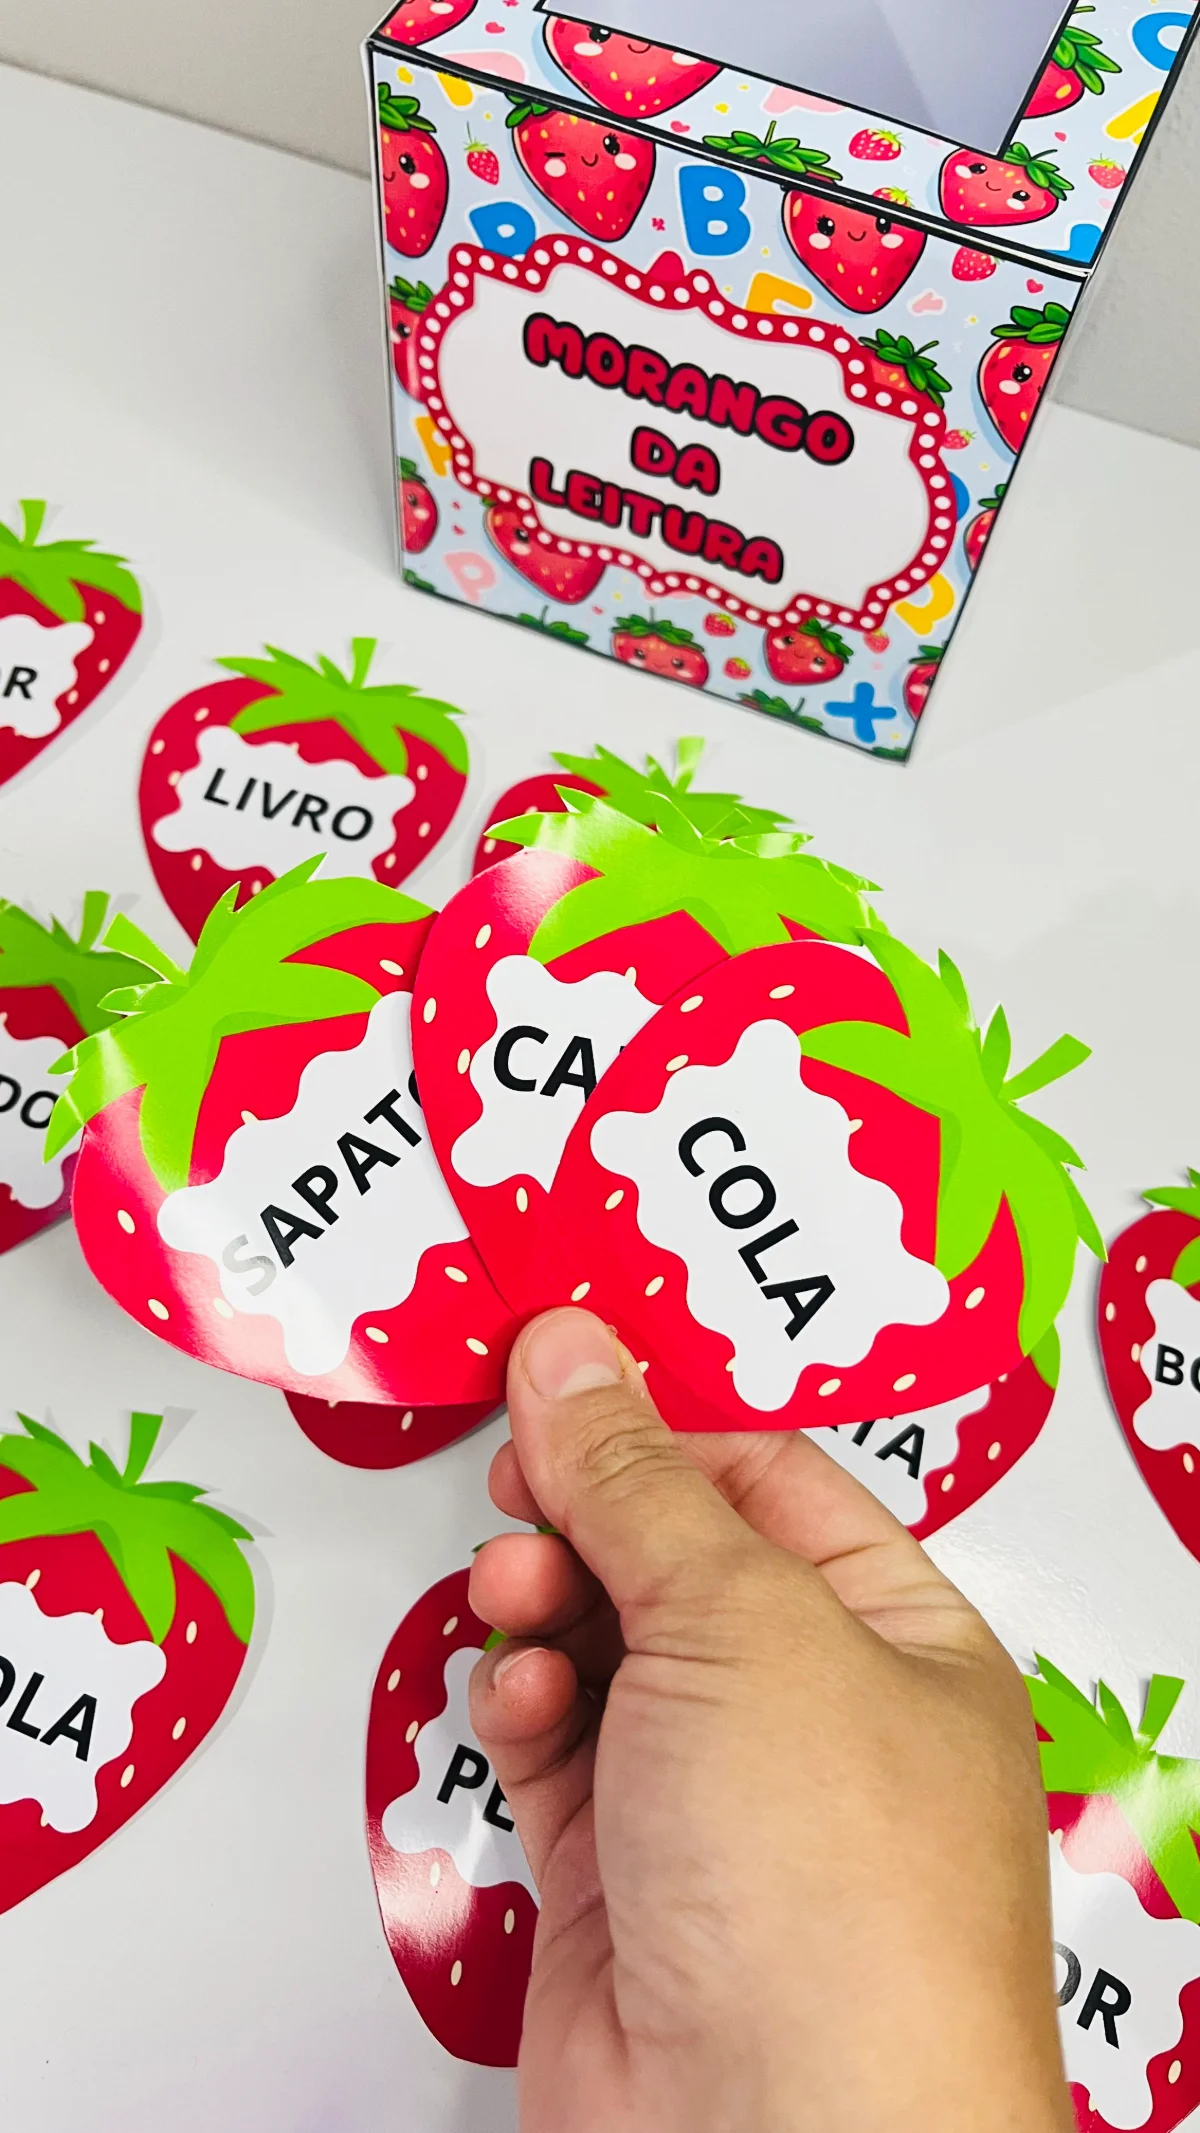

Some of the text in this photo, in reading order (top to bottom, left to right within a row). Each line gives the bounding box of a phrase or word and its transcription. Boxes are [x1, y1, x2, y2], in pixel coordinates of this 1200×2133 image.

[523, 312, 855, 465] MORANGO
[529, 456, 784, 584] LEITURA
[630, 426, 721, 495] DA
[203, 767, 374, 841] LIVRO
[493, 1025, 627, 1104] CA
[221, 1068, 424, 1296] SAPAT
[678, 1116, 836, 1341] COLA
